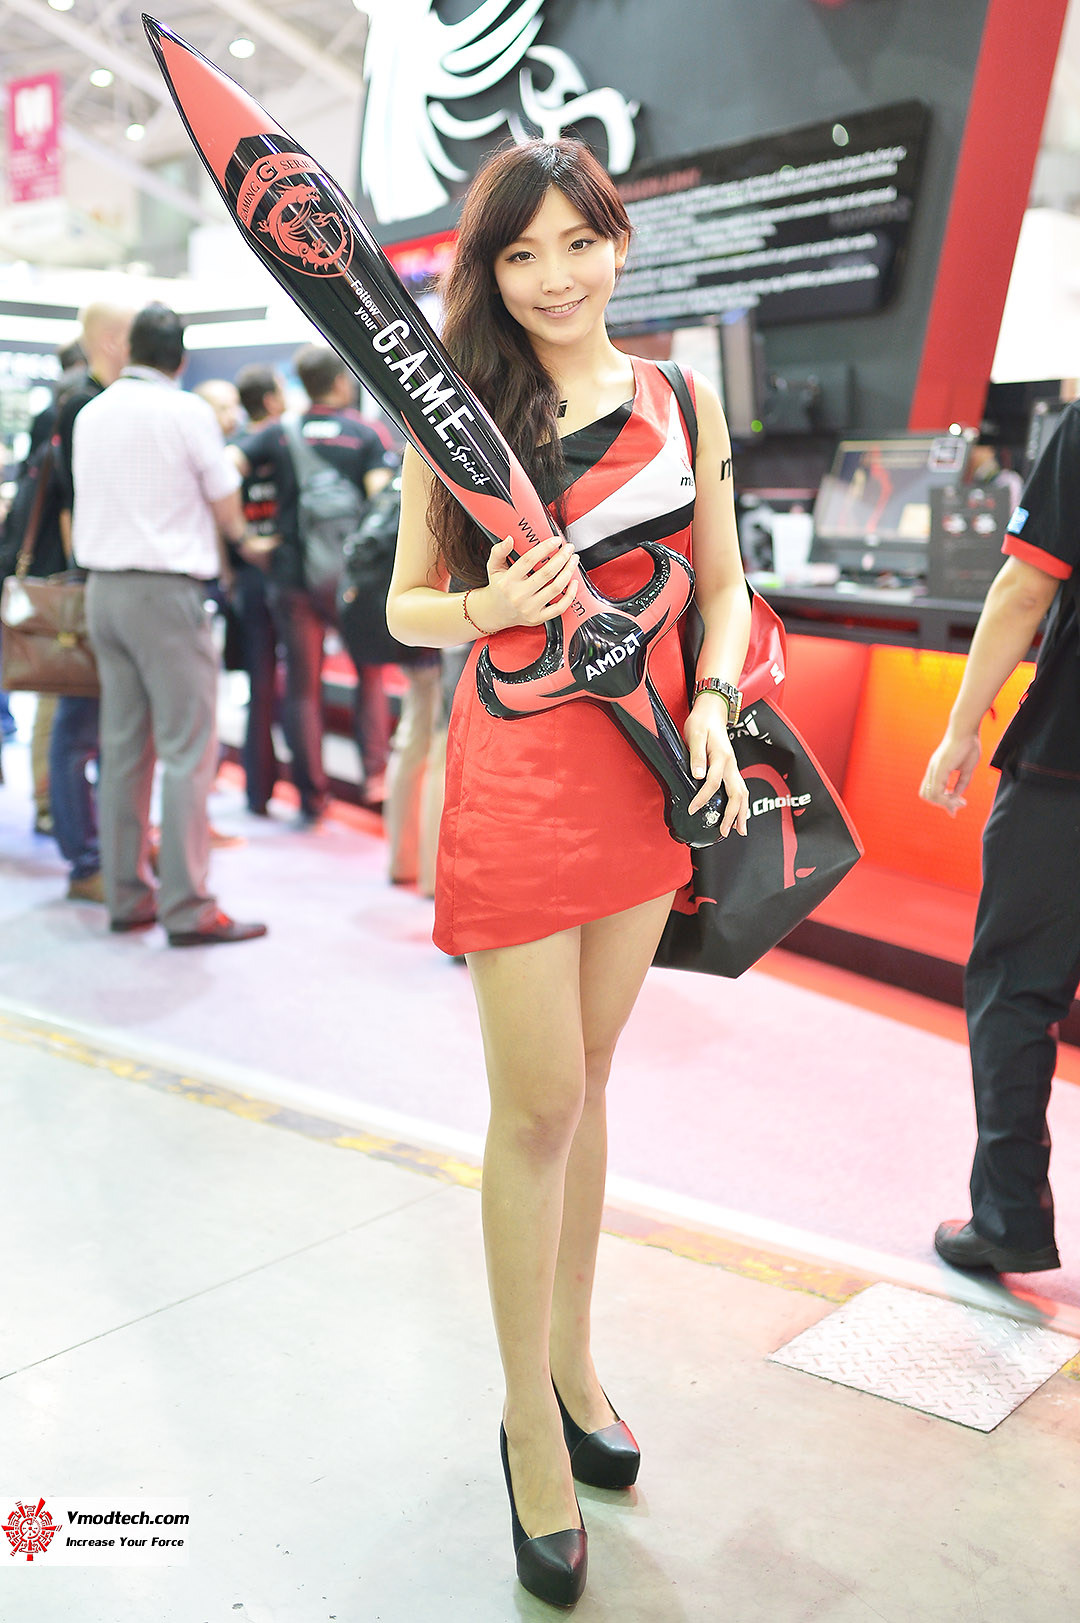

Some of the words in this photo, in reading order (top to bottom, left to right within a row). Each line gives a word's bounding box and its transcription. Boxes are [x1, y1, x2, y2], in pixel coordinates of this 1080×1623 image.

[240, 181, 261, 222] GAMING
[256, 160, 279, 183] G
[350, 280, 380, 316] Follow
[354, 306, 378, 331] your
[372, 319, 476, 449] G.A.M.E.
[450, 445, 491, 486] Spirit
[584, 645, 628, 682] AMD
[752, 793, 812, 816] Choice
